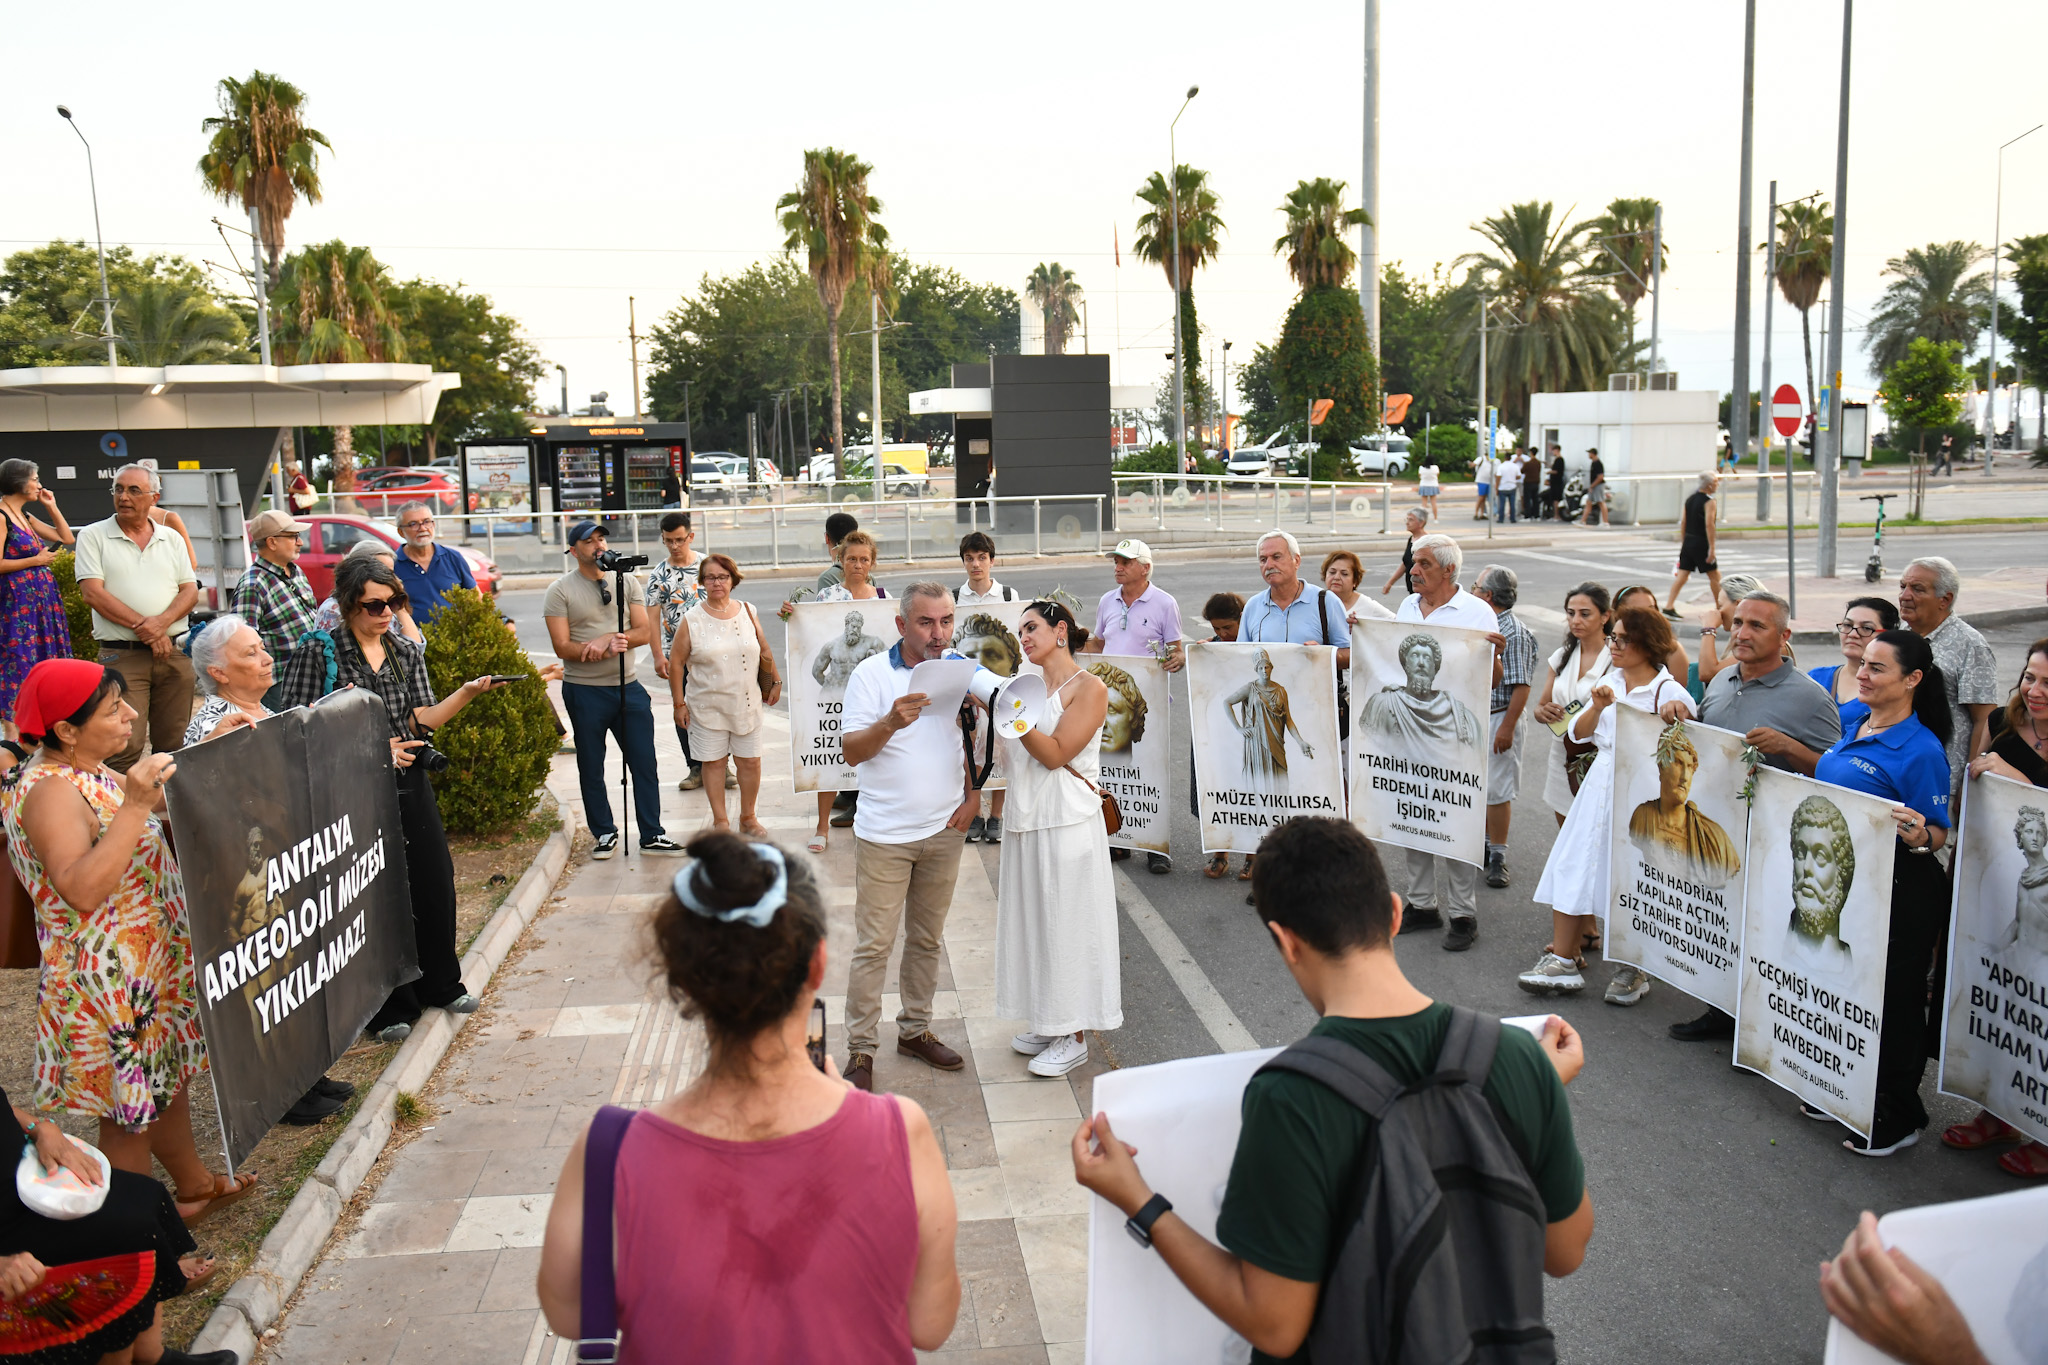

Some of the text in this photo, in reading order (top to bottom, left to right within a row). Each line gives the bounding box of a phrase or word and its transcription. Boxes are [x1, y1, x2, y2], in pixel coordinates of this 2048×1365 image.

[800, 753, 846, 767] YIKIYO
[813, 734, 835, 749] SİZ
[1099, 766, 1141, 780] ENTİMİ
[1359, 753, 1483, 791] "TARİHİ KORUMAK,
[1848, 756, 1877, 775] PARS
[1116, 797, 1158, 814] İZ ONU
[1122, 783, 1160, 800] ETTİM;
[1207, 789, 1336, 812] "MÜZE YIKILIRSA,
[1372, 776, 1472, 809] ERDEMLİ AKLIN
[1397, 798, 1447, 823] İŞİDİR."
[1211, 811, 1268, 827] ATHENA
[266, 813, 354, 902] ANTALYA
[1639, 861, 1727, 912] "BEN HADRİAN,
[204, 828, 386, 1010] ARKEOLOJİ MÜZESİ
[1619, 893, 1639, 912] SİZ
[1642, 902, 1681, 931] TARİHE
[1685, 921, 1727, 952] DUVAR
[1637, 880, 1729, 933] KAPILAR AÇTIM;
[1632, 914, 1733, 972] ÖRÜYORSUNUZ?"
[254, 909, 366, 1033] YIKILAMAZ!
[1750, 956, 1808, 1001] "GEÇMİŞİ
[1811, 984, 1840, 1015] YOK
[1970, 985, 1998, 1014] BU
[1768, 993, 1866, 1058] GELECEĞİNİ DE
[1969, 1011, 2032, 1065] İLHAM
[1773, 1022, 1854, 1077] KAYBEDER."
